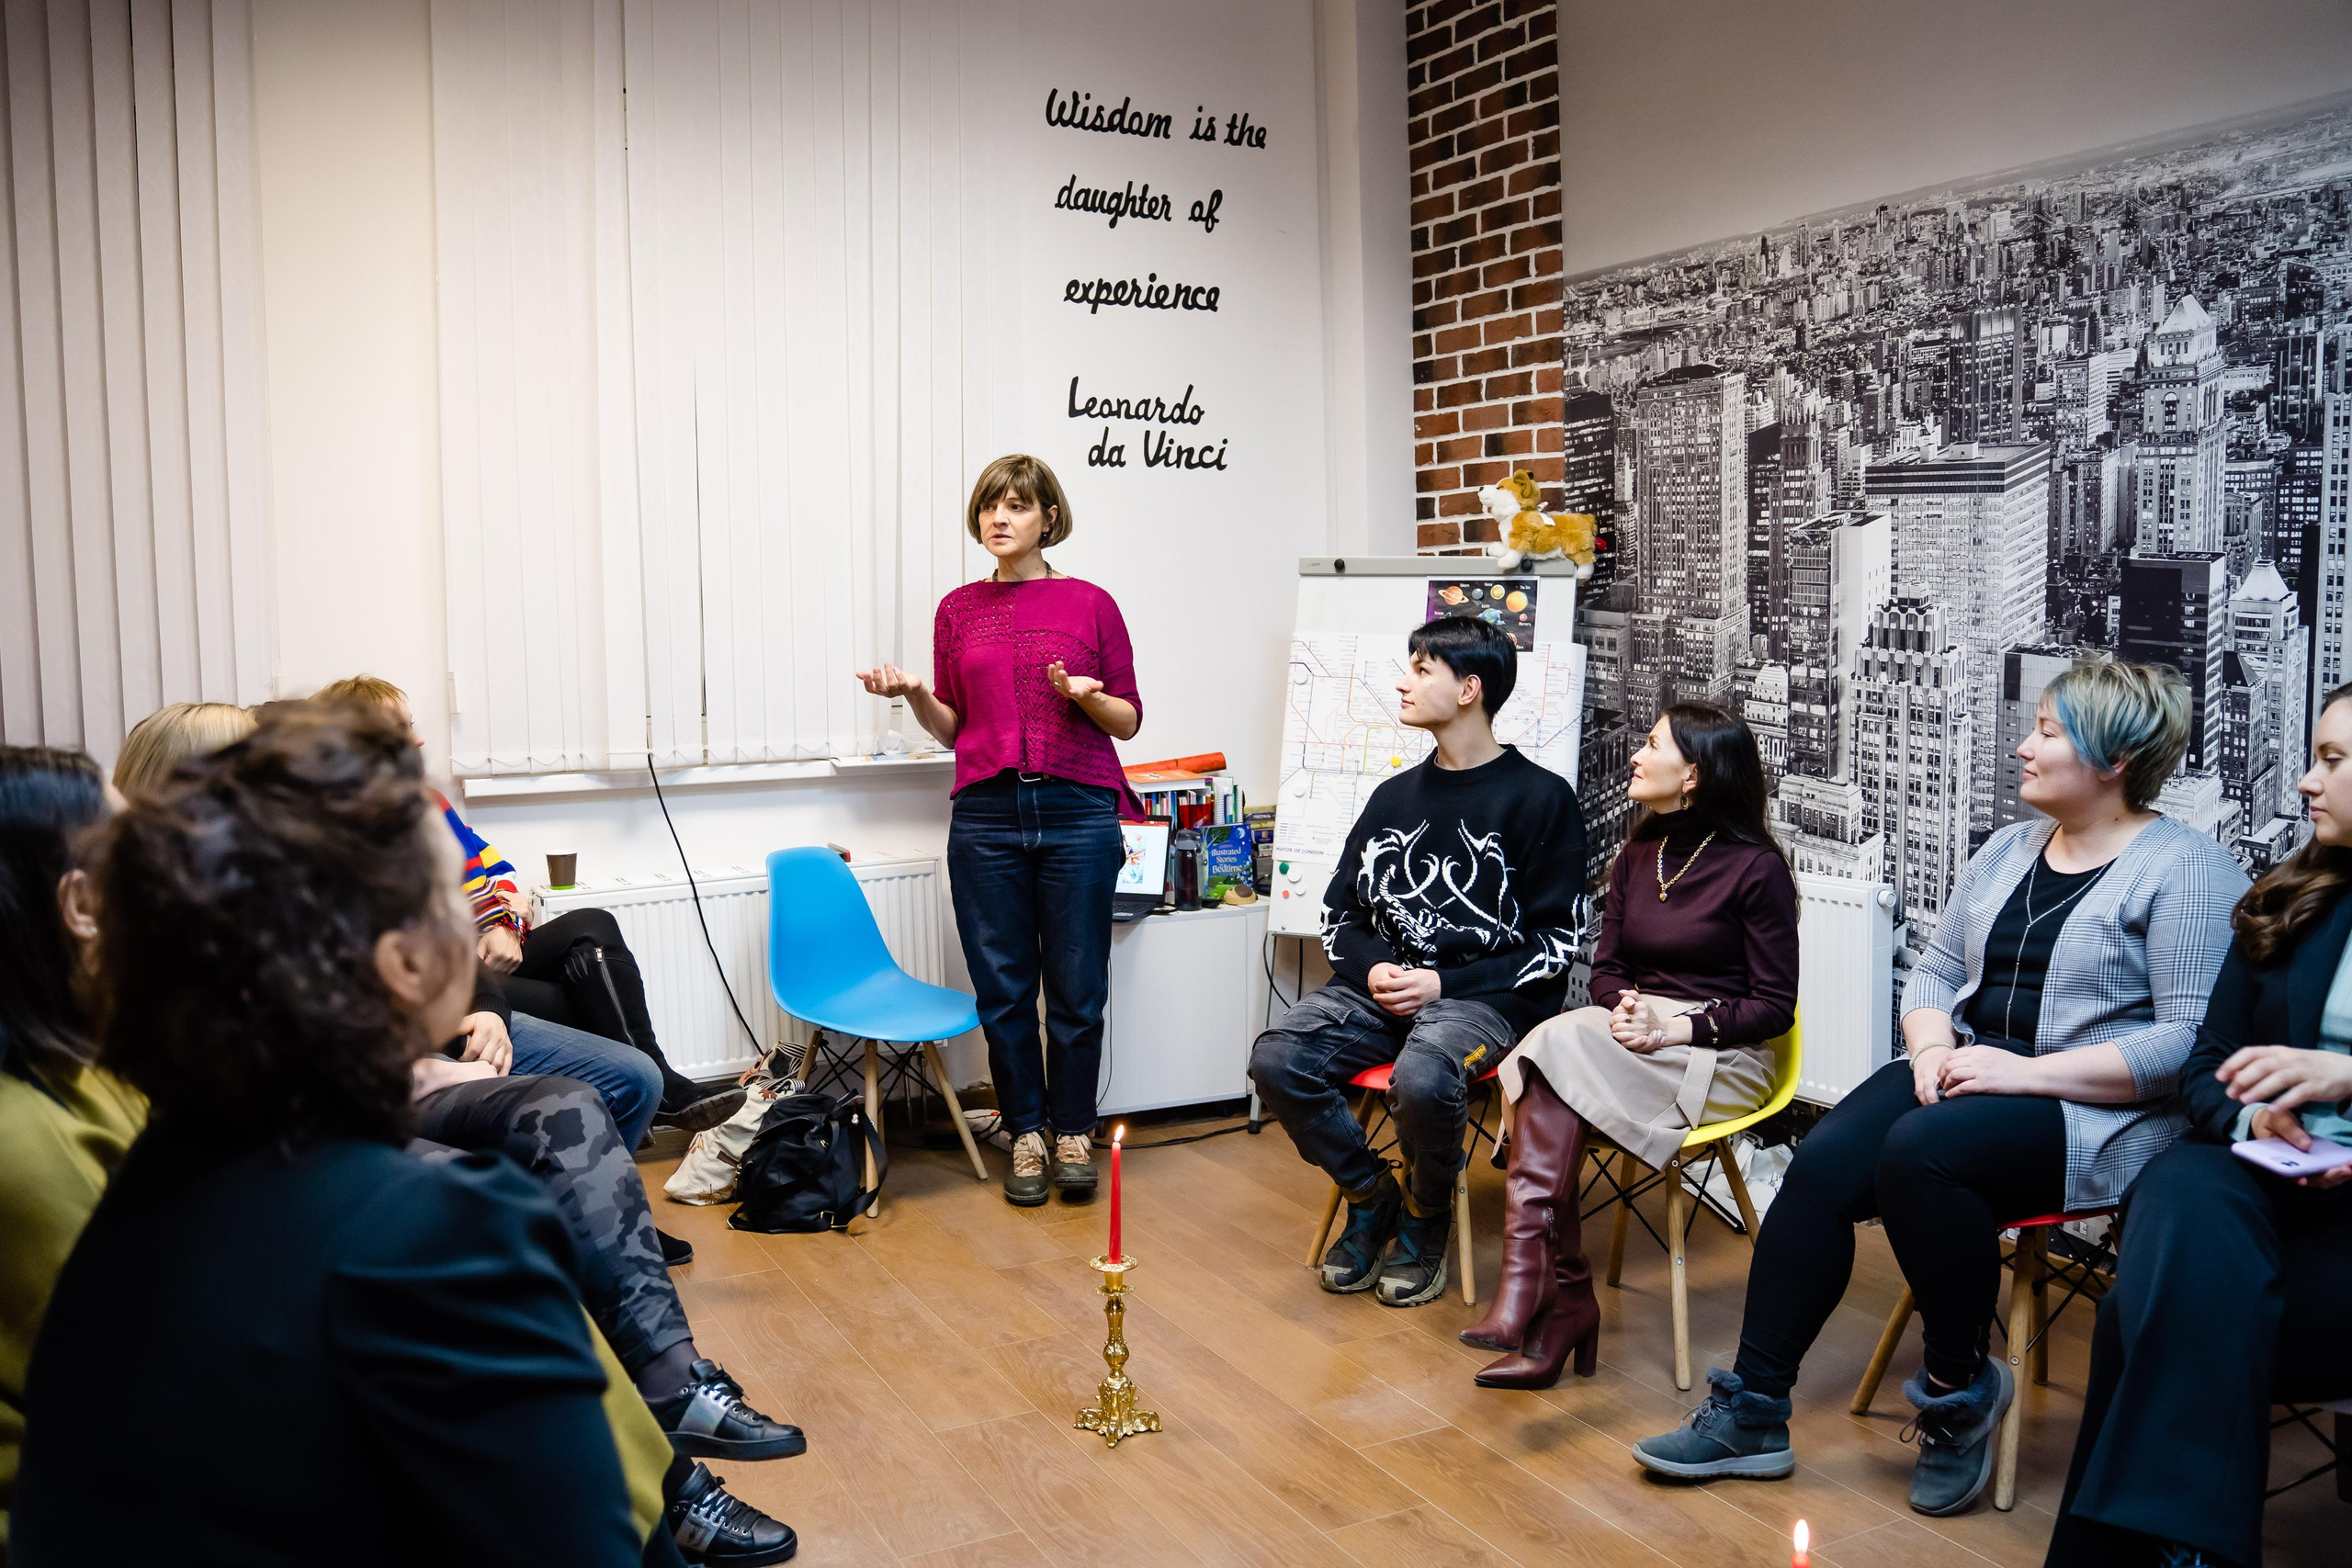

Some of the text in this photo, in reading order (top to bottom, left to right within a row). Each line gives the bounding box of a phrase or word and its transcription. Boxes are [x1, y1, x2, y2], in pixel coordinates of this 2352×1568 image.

[1046, 87, 1267, 150] Wisdom is the
[1054, 174, 1224, 234] daughter of
[1063, 272, 1220, 315] experience
[1068, 376, 1205, 425] Leonardo
[1088, 425, 1228, 471] da Vinci
[1211, 847, 1241, 856] Illustrated
[1212, 863, 1243, 874] Bedtime
